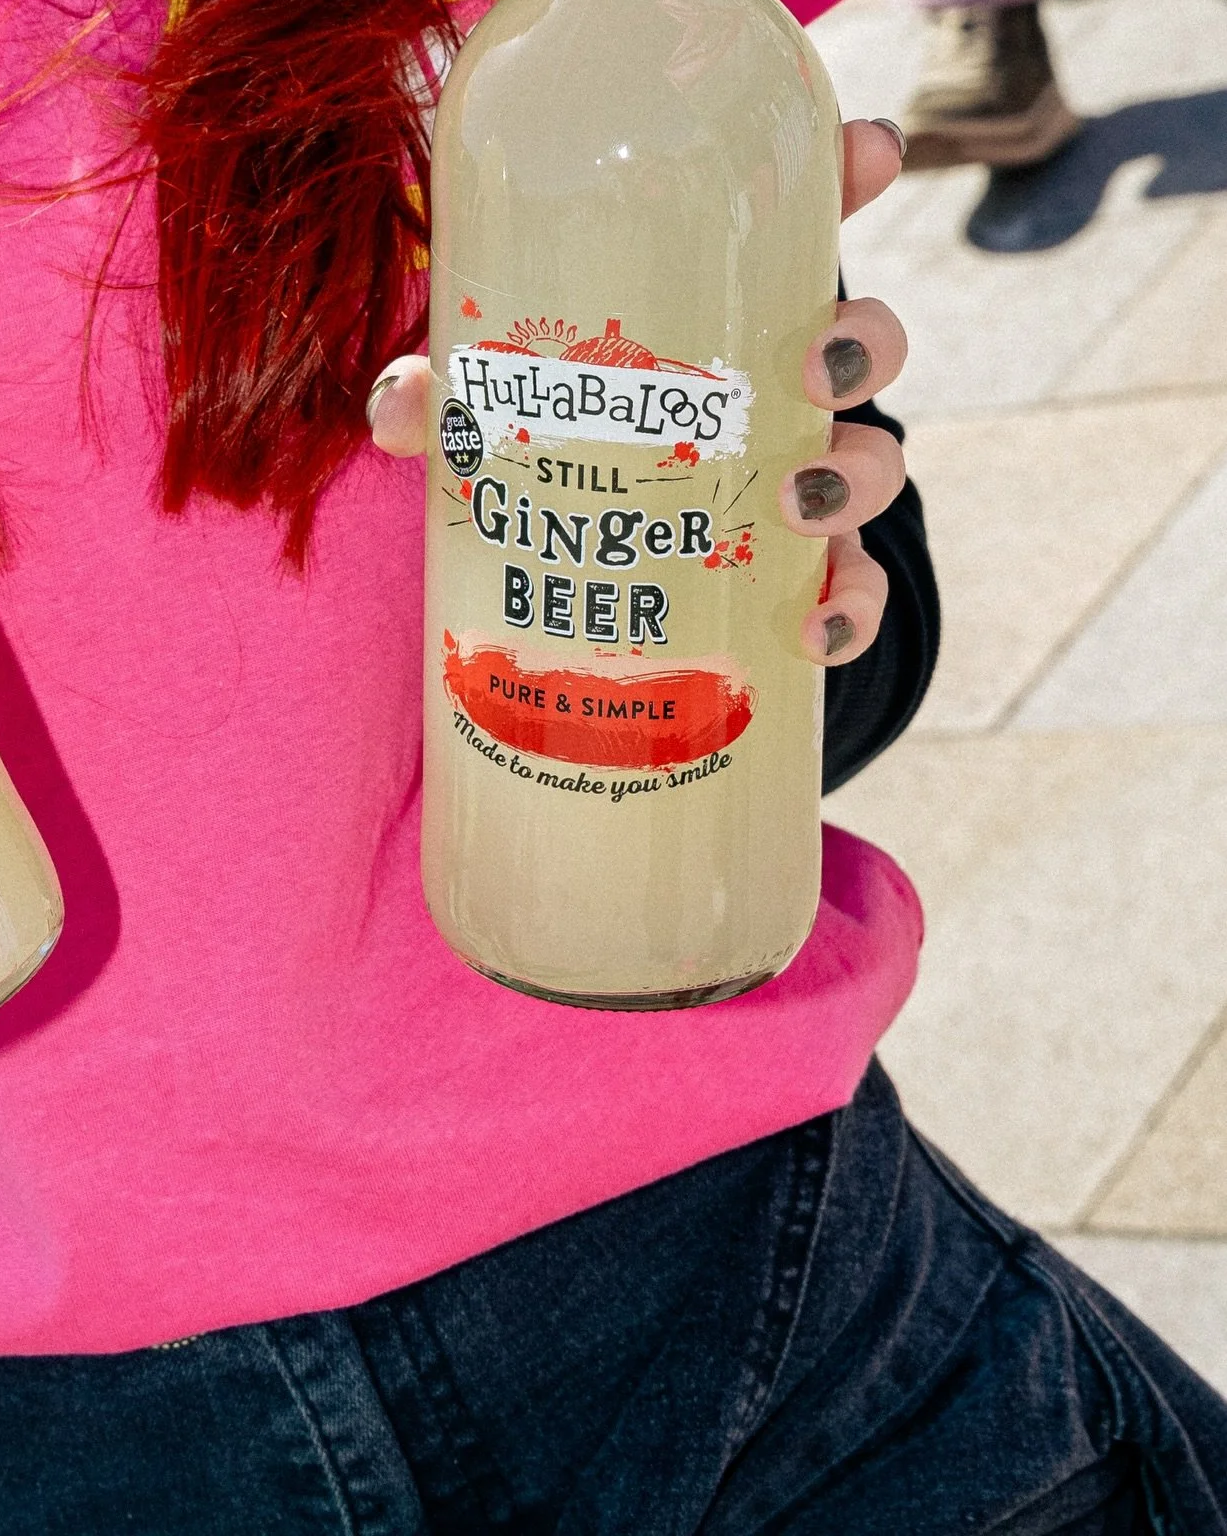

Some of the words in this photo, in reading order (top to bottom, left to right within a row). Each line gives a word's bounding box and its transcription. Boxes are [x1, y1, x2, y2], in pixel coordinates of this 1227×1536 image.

[442, 429, 482, 451] taste
[446, 414, 467, 431] great
[537, 457, 628, 494] STILL
[504, 563, 668, 644] BEER
[490, 674, 546, 709] PURE
[556, 694, 571, 713] &
[582, 698, 675, 720] SIMPLE
[454, 711, 507, 767] Made
[510, 755, 534, 779] to
[536, 772, 606, 795] make
[611, 775, 661, 803] you
[666, 751, 732, 788] smile
